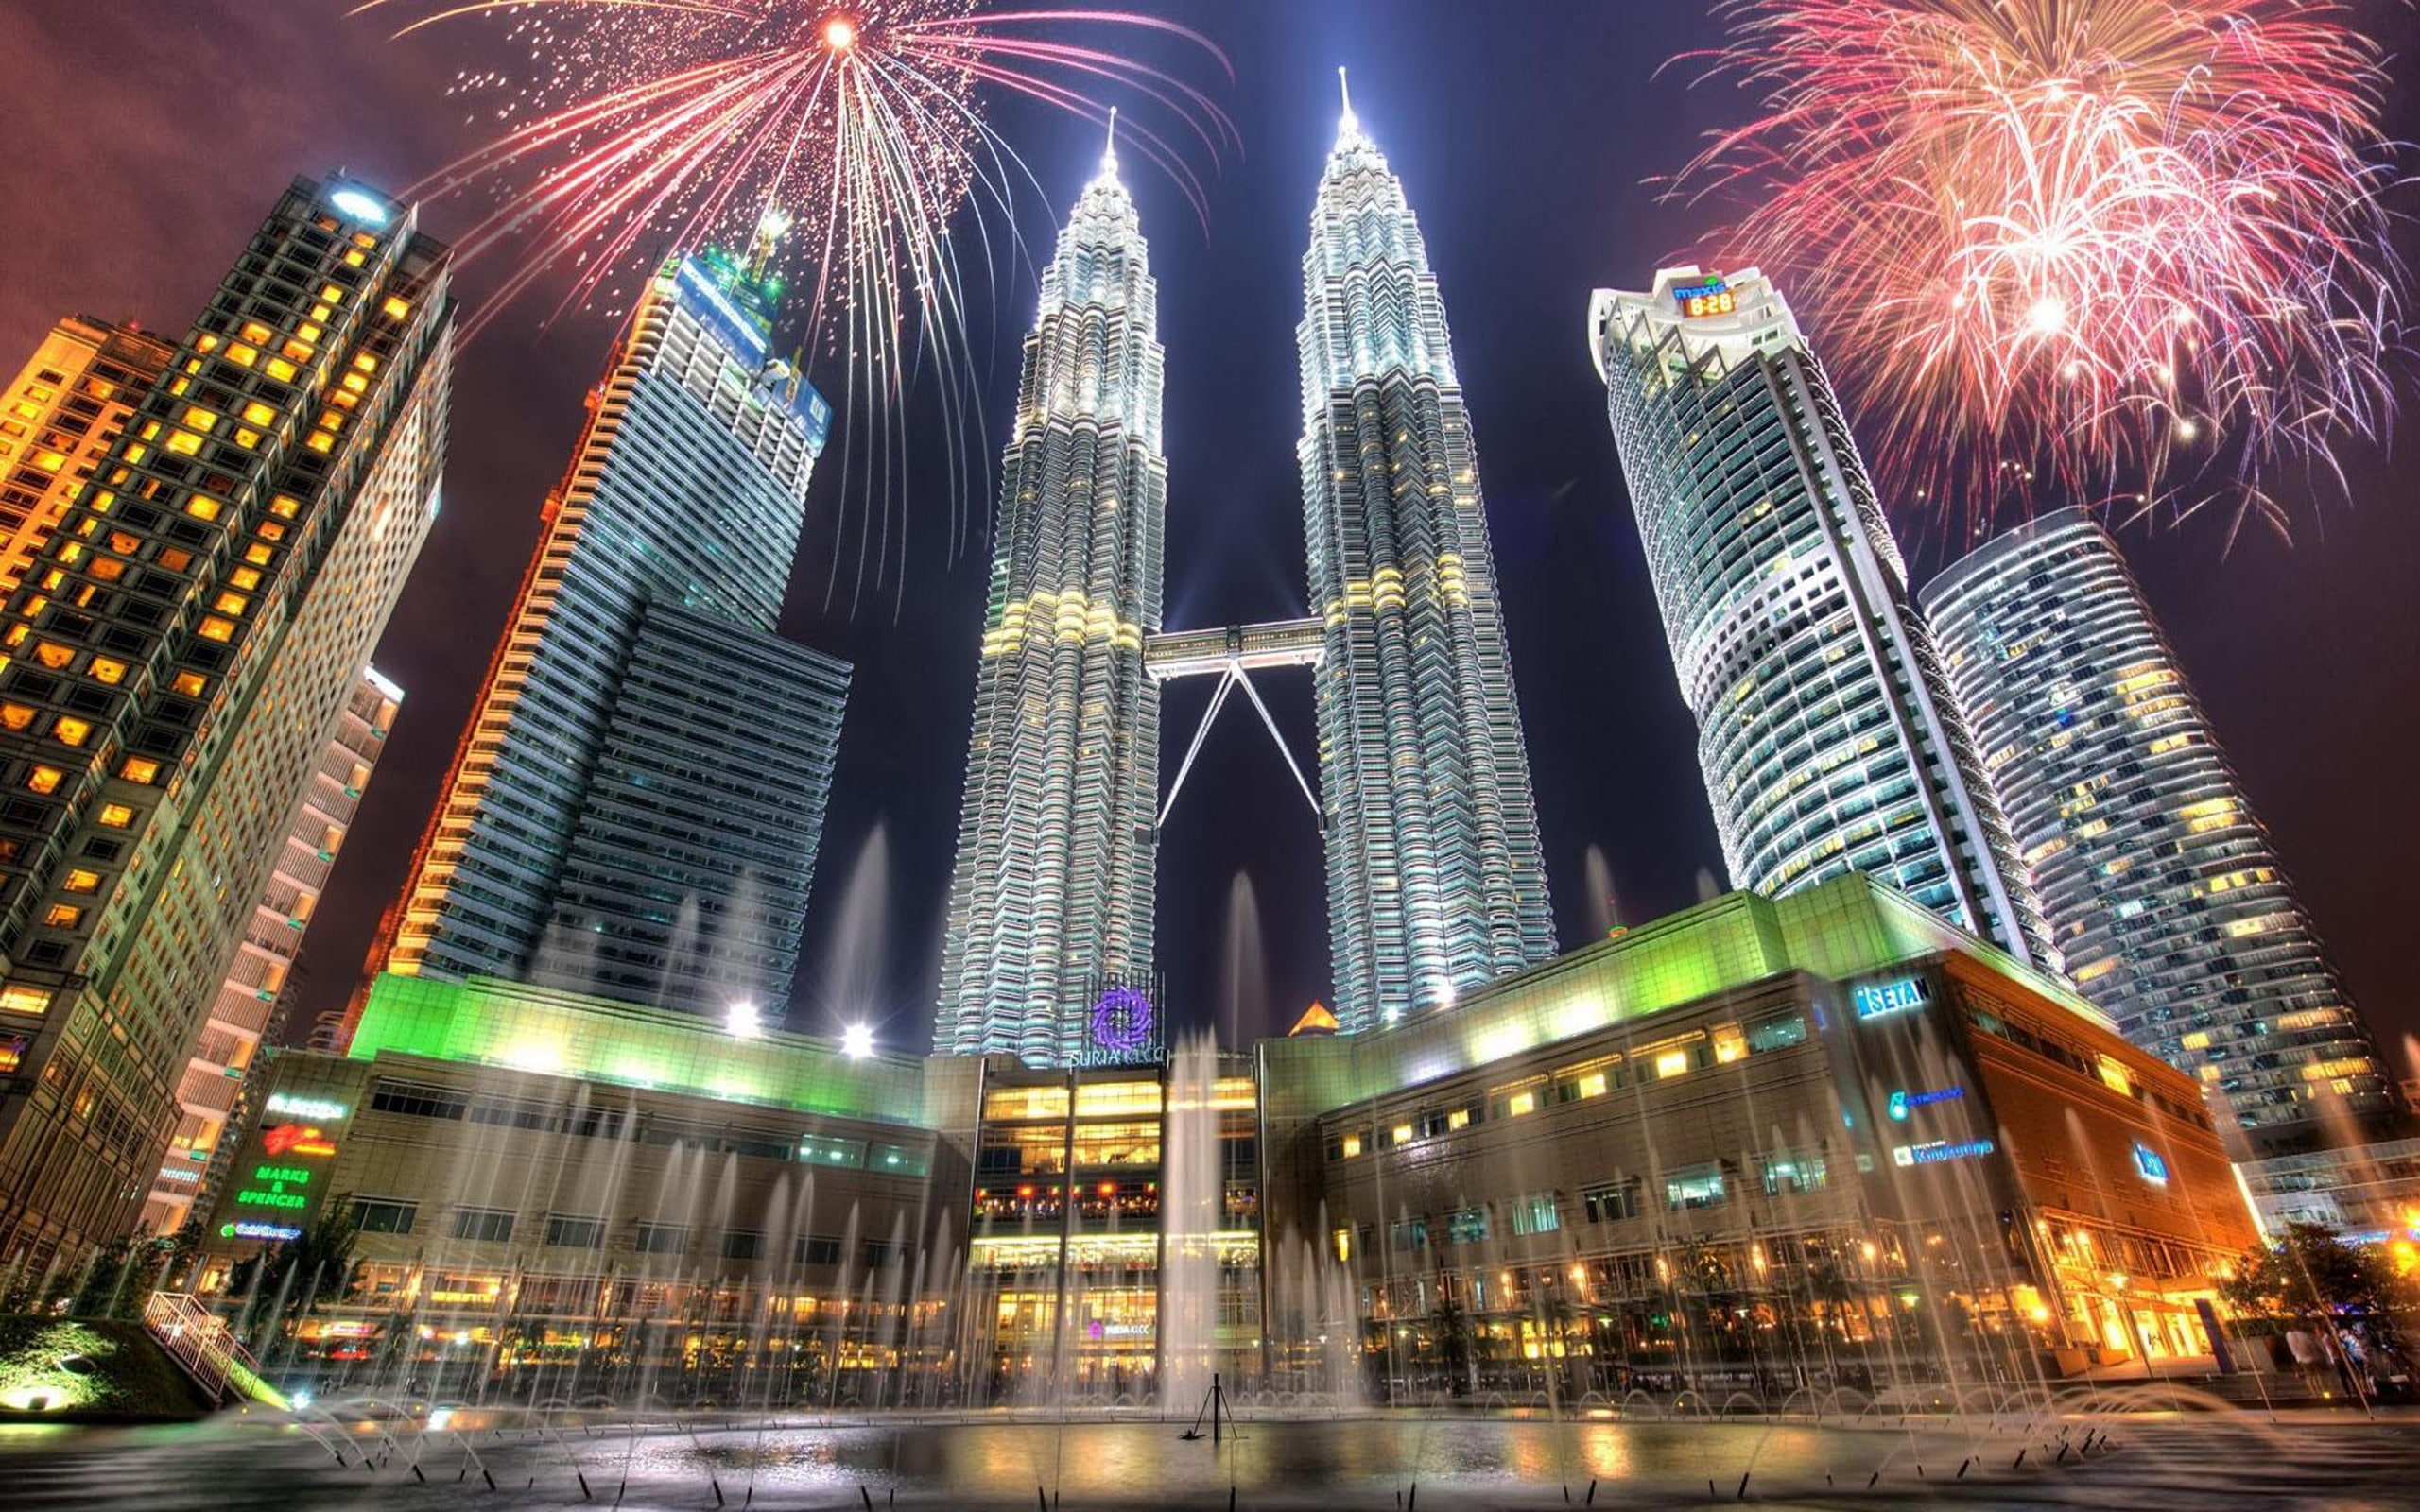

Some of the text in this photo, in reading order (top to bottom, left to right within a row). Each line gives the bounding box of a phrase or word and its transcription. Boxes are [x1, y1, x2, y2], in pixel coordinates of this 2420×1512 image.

[1070, 1046, 1165, 1067] SURIA KLCC
[255, 1166, 310, 1184] MARKS
[238, 1191, 306, 1209] SPENCER
